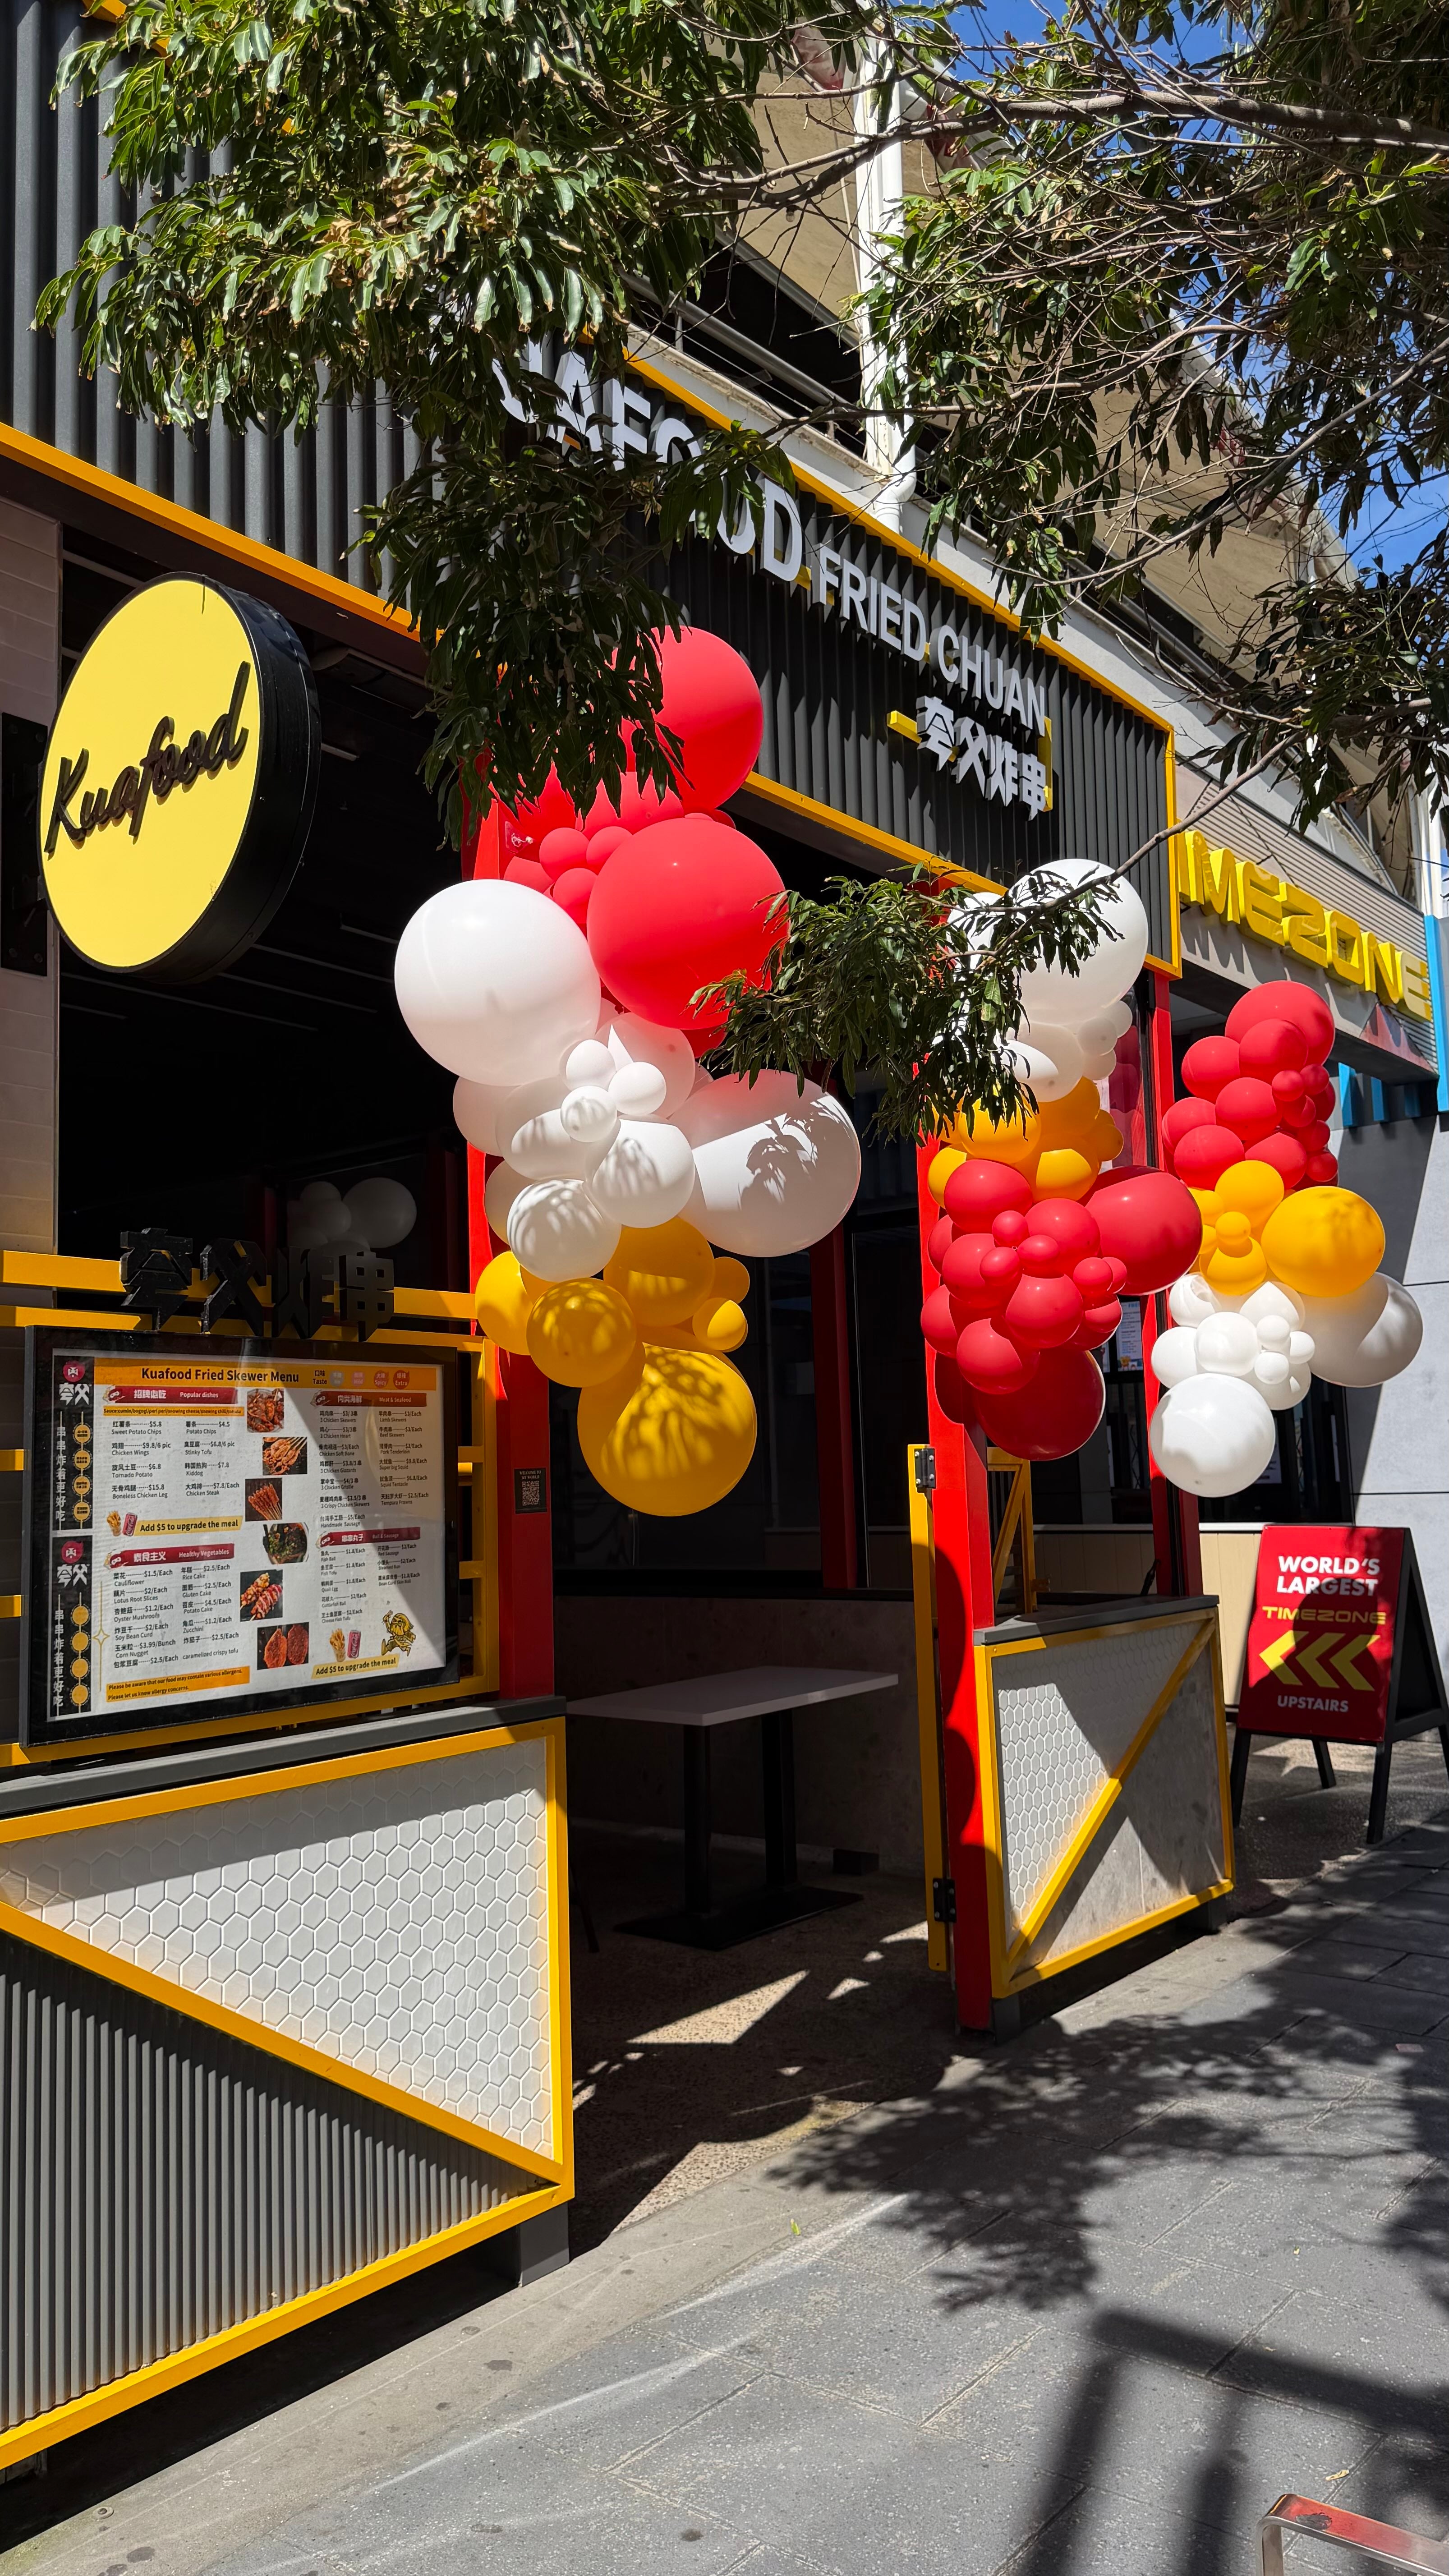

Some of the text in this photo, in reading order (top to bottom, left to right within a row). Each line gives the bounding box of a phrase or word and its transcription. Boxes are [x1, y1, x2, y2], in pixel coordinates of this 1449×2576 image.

[810, 544, 926, 663] FRIED
[930, 626, 1047, 737] CHUAN
[44, 661, 251, 856] Kuafood
[916, 695, 1047, 820] 夸父炸串
[1177, 830, 1432, 1023] IMEZONE
[120, 1228, 395, 1342] 夸父炸串
[142, 1368, 299, 1382] Kuafood Fried Skewer Menu
[59, 1382, 90, 1406] 夸父
[157, 1523, 166, 1532] $5
[177, 1522, 206, 1531] upgrade
[201, 1548, 229, 1556] Vegetables
[204, 1564, 230, 1572] $2.5/Each
[1278, 1555, 1380, 1575] WORLD'S
[57, 1564, 88, 1587] 夸父
[144, 1569, 173, 1578] $1.5/Each
[204, 1581, 231, 1589] $2.5/Each
[1276, 1576, 1378, 1596] LARGEST
[144, 1587, 167, 1595] $2/Each
[205, 1598, 231, 1606] $4.5/Each
[145, 1604, 174, 1612] $1.2/Each
[1262, 1606, 1386, 1625] TIMEZONE
[145, 1623, 169, 1631] $2/Each
[212, 1632, 239, 1641] $2.5/Each
[139, 1639, 176, 1649] $3.99/Bunch
[150, 1656, 179, 1664] $2.5/Each
[183, 1651, 212, 1660] caramelized
[345, 1661, 370, 1671] upgrade
[1277, 1695, 1349, 1712] UPSTAIRS
